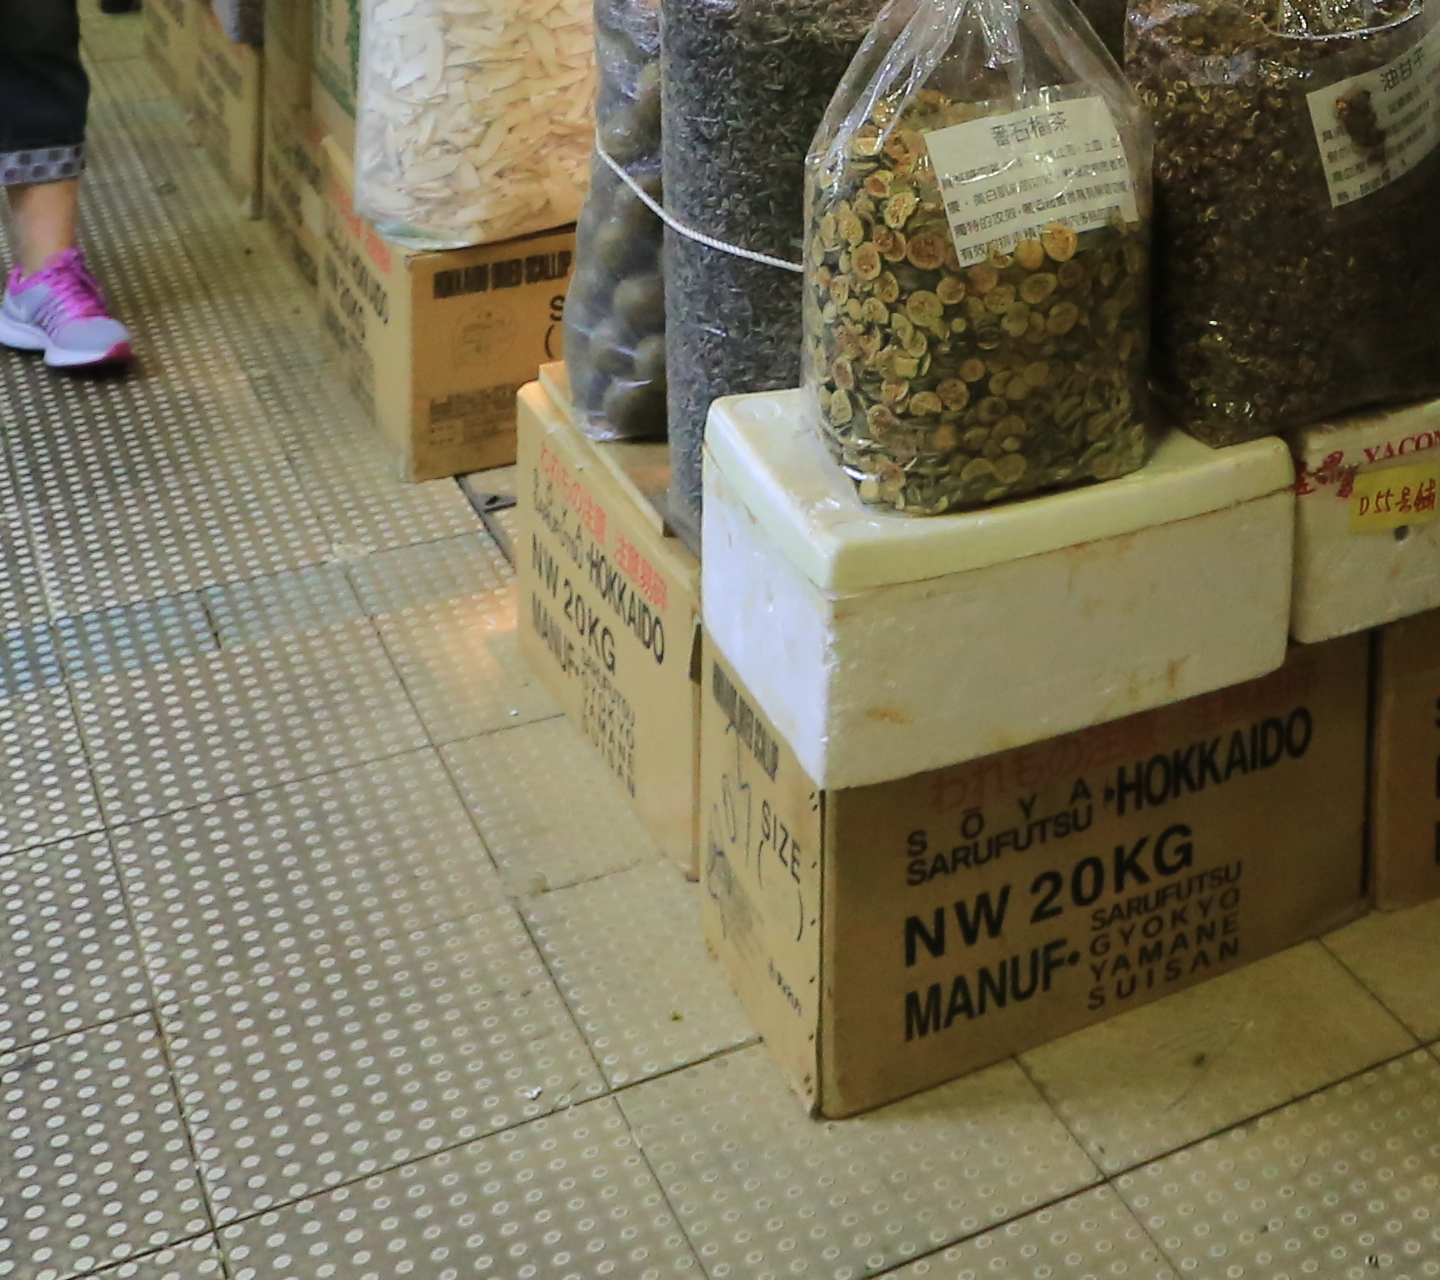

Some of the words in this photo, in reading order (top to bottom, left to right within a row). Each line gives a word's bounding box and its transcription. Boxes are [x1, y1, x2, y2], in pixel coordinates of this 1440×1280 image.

[531, 534, 559, 599] NW
[563, 577, 616, 675] 20KG
[762, 799, 802, 885] SIZE
[906, 803, 1094, 888] SARUFUTSU
[904, 883, 1012, 968] NW
[1029, 822, 1195, 926] 20KG
[1090, 859, 1244, 934] SARUFUTSU
